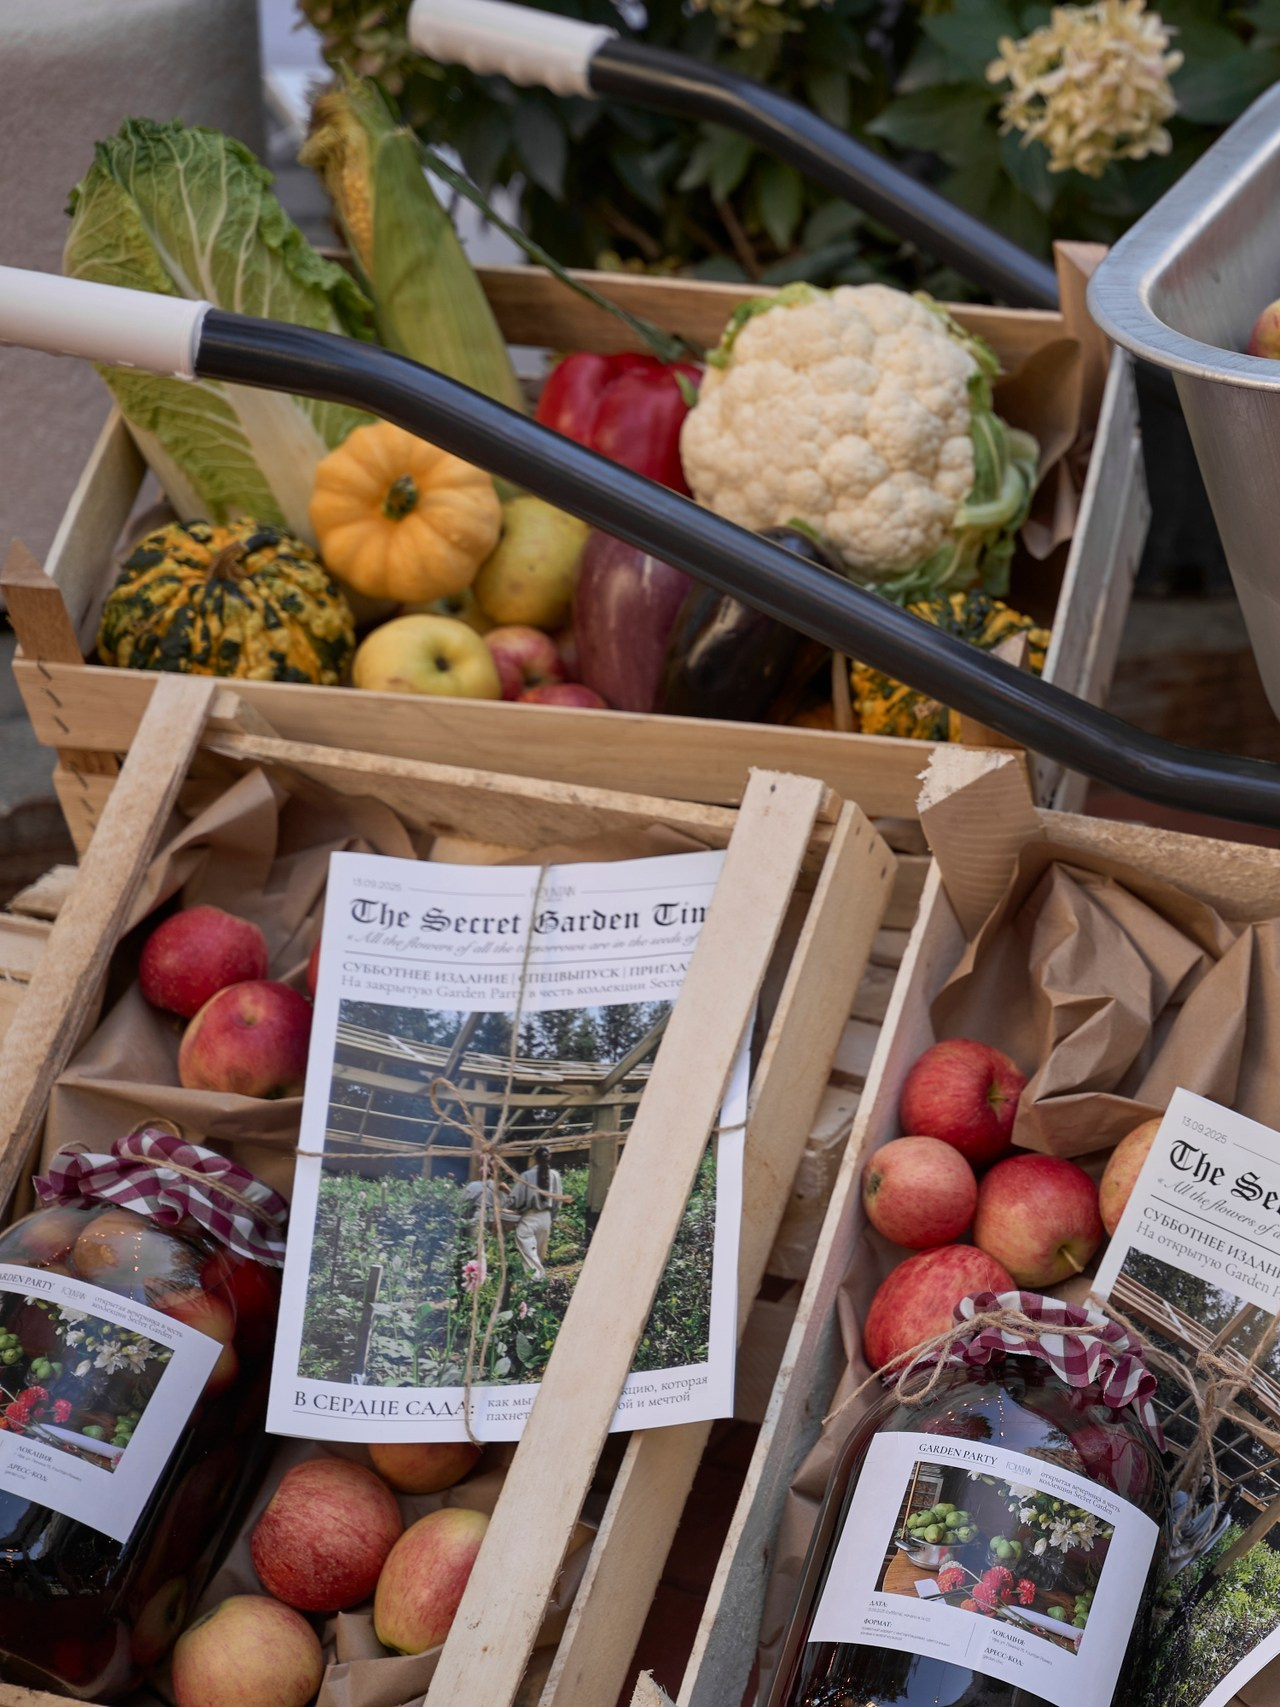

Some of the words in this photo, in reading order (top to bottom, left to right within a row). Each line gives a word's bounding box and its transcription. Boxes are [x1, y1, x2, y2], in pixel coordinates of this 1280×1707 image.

[350, 898, 411, 930] The
[420, 907, 522, 934] Secret
[531, 910, 640, 934] Garden
[652, 902, 708, 926] Tim
[341, 975, 362, 987] На
[365, 980, 433, 999] закрытую
[436, 985, 486, 999] Garden
[490, 987, 525, 1000] Part
[649, 977, 684, 989] Secre
[343, 961, 431, 980] СУББОТНЕЕ
[435, 971, 510, 985] ИЗДАНИЕ
[629, 962, 690, 977] ПРИГЛА
[1181, 1115, 1228, 1145] 13.09.2025
[1169, 1140, 1225, 1186] The
[1164, 1177, 1192, 1197] All
[1190, 1190, 1209, 1207] the
[1200, 1196, 1257, 1228] flowers
[1253, 1223, 1280, 1236] of
[1143, 1207, 1225, 1253] СУББОТНЕЕ
[1136, 1220, 1155, 1241] На
[1157, 1234, 1222, 1270] открытую
[1224, 1260, 1270, 1294] Garden
[24, 1276, 55, 1290] PARTY
[294, 1391, 306, 1406] В
[313, 1394, 399, 1417] СЕРДЦЕ
[486, 1411, 531, 1421] пахнет
[637, 1399, 645, 1408] и
[648, 1391, 690, 1407] мечтой
[488, 1399, 510, 1408] как
[512, 1397, 532, 1407] мы
[661, 1376, 708, 1391] которая
[919, 1443, 962, 1458] GARDEN
[963, 1449, 998, 1465] PARTY
[1039, 1478, 1073, 1495] коллекции
[1073, 1491, 1092, 1504] Secret
[1092, 1500, 1113, 1515] Garden
[1040, 1472, 1071, 1488] открытая
[1072, 1484, 1102, 1502] вечеринка
[863, 1618, 892, 1628] ФОРМАТ:
